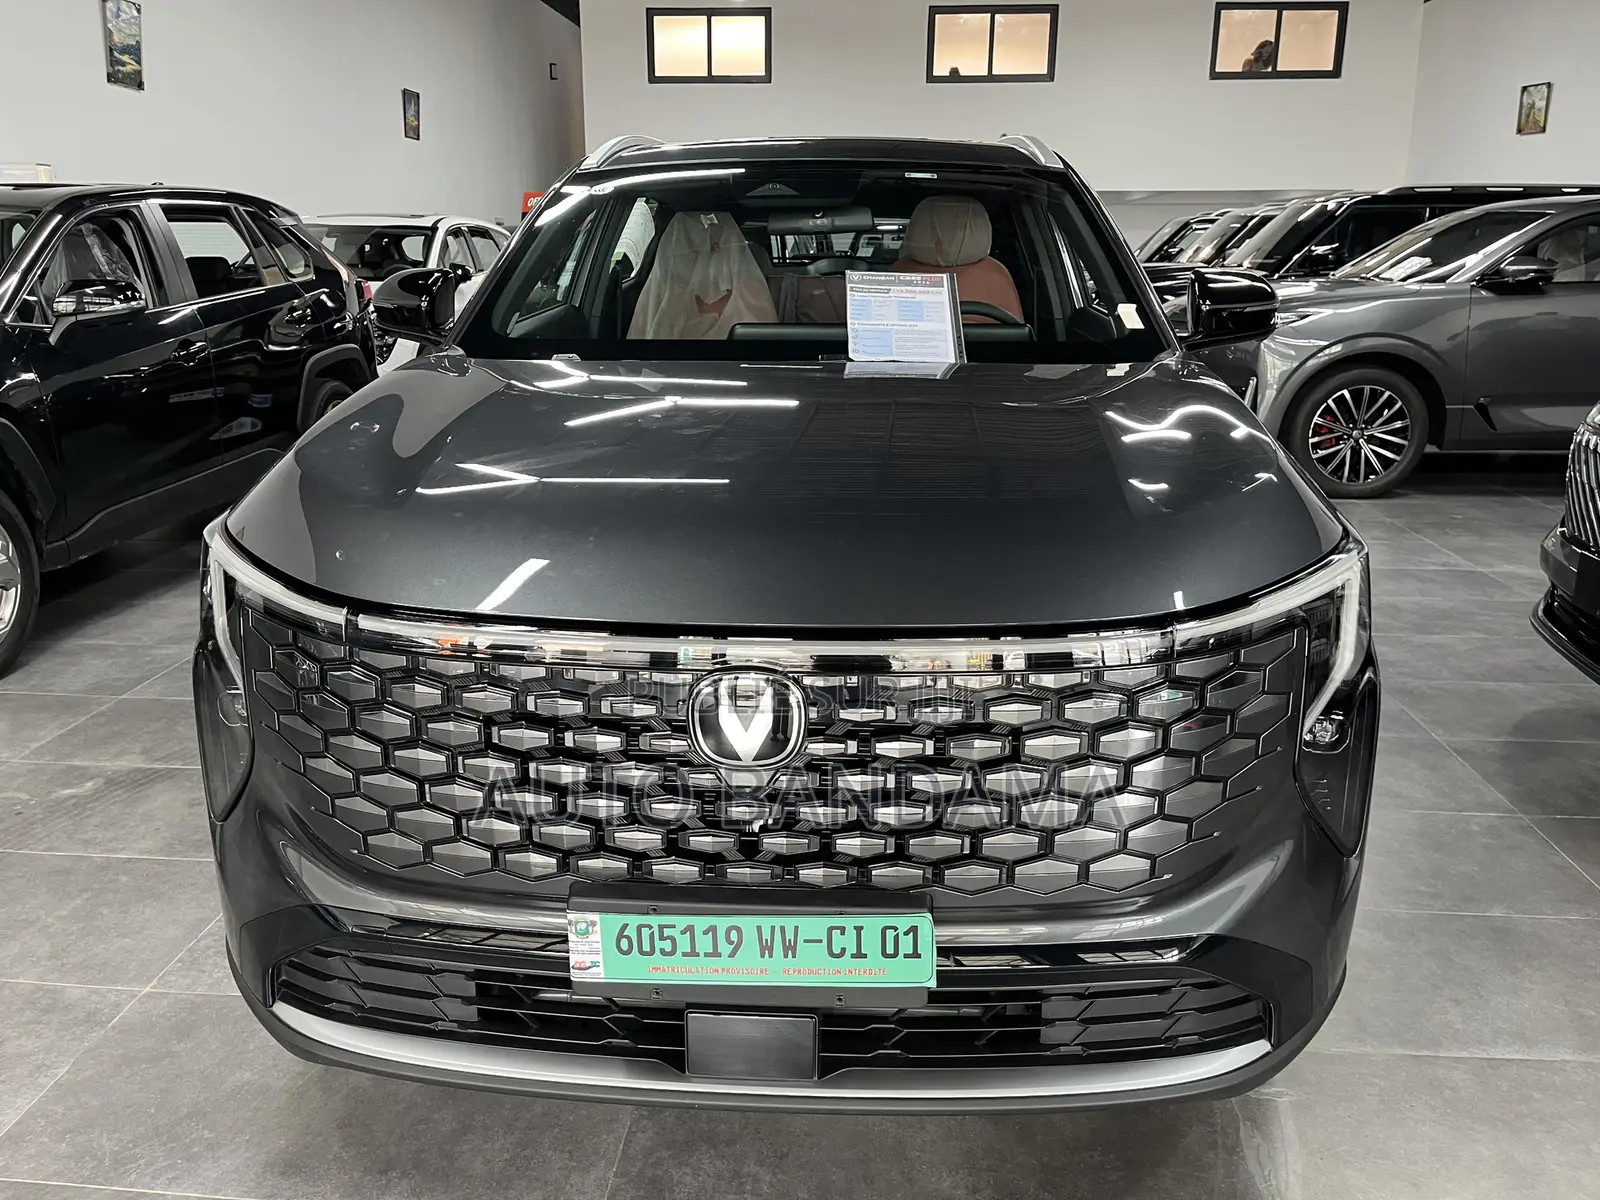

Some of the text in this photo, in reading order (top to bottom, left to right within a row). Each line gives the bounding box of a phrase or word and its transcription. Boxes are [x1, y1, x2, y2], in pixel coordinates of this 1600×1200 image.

[615, 923, 744, 959] 605119
[756, 924, 868, 960] WW-CI
[880, 924, 922, 959] 01
[648, 965, 719, 975] IMMATRICULATION
[721, 967, 769, 976] PROVISOIRE
[782, 967, 842, 976] REPRODUCTION
[844, 967, 887, 976] INTERDITE
